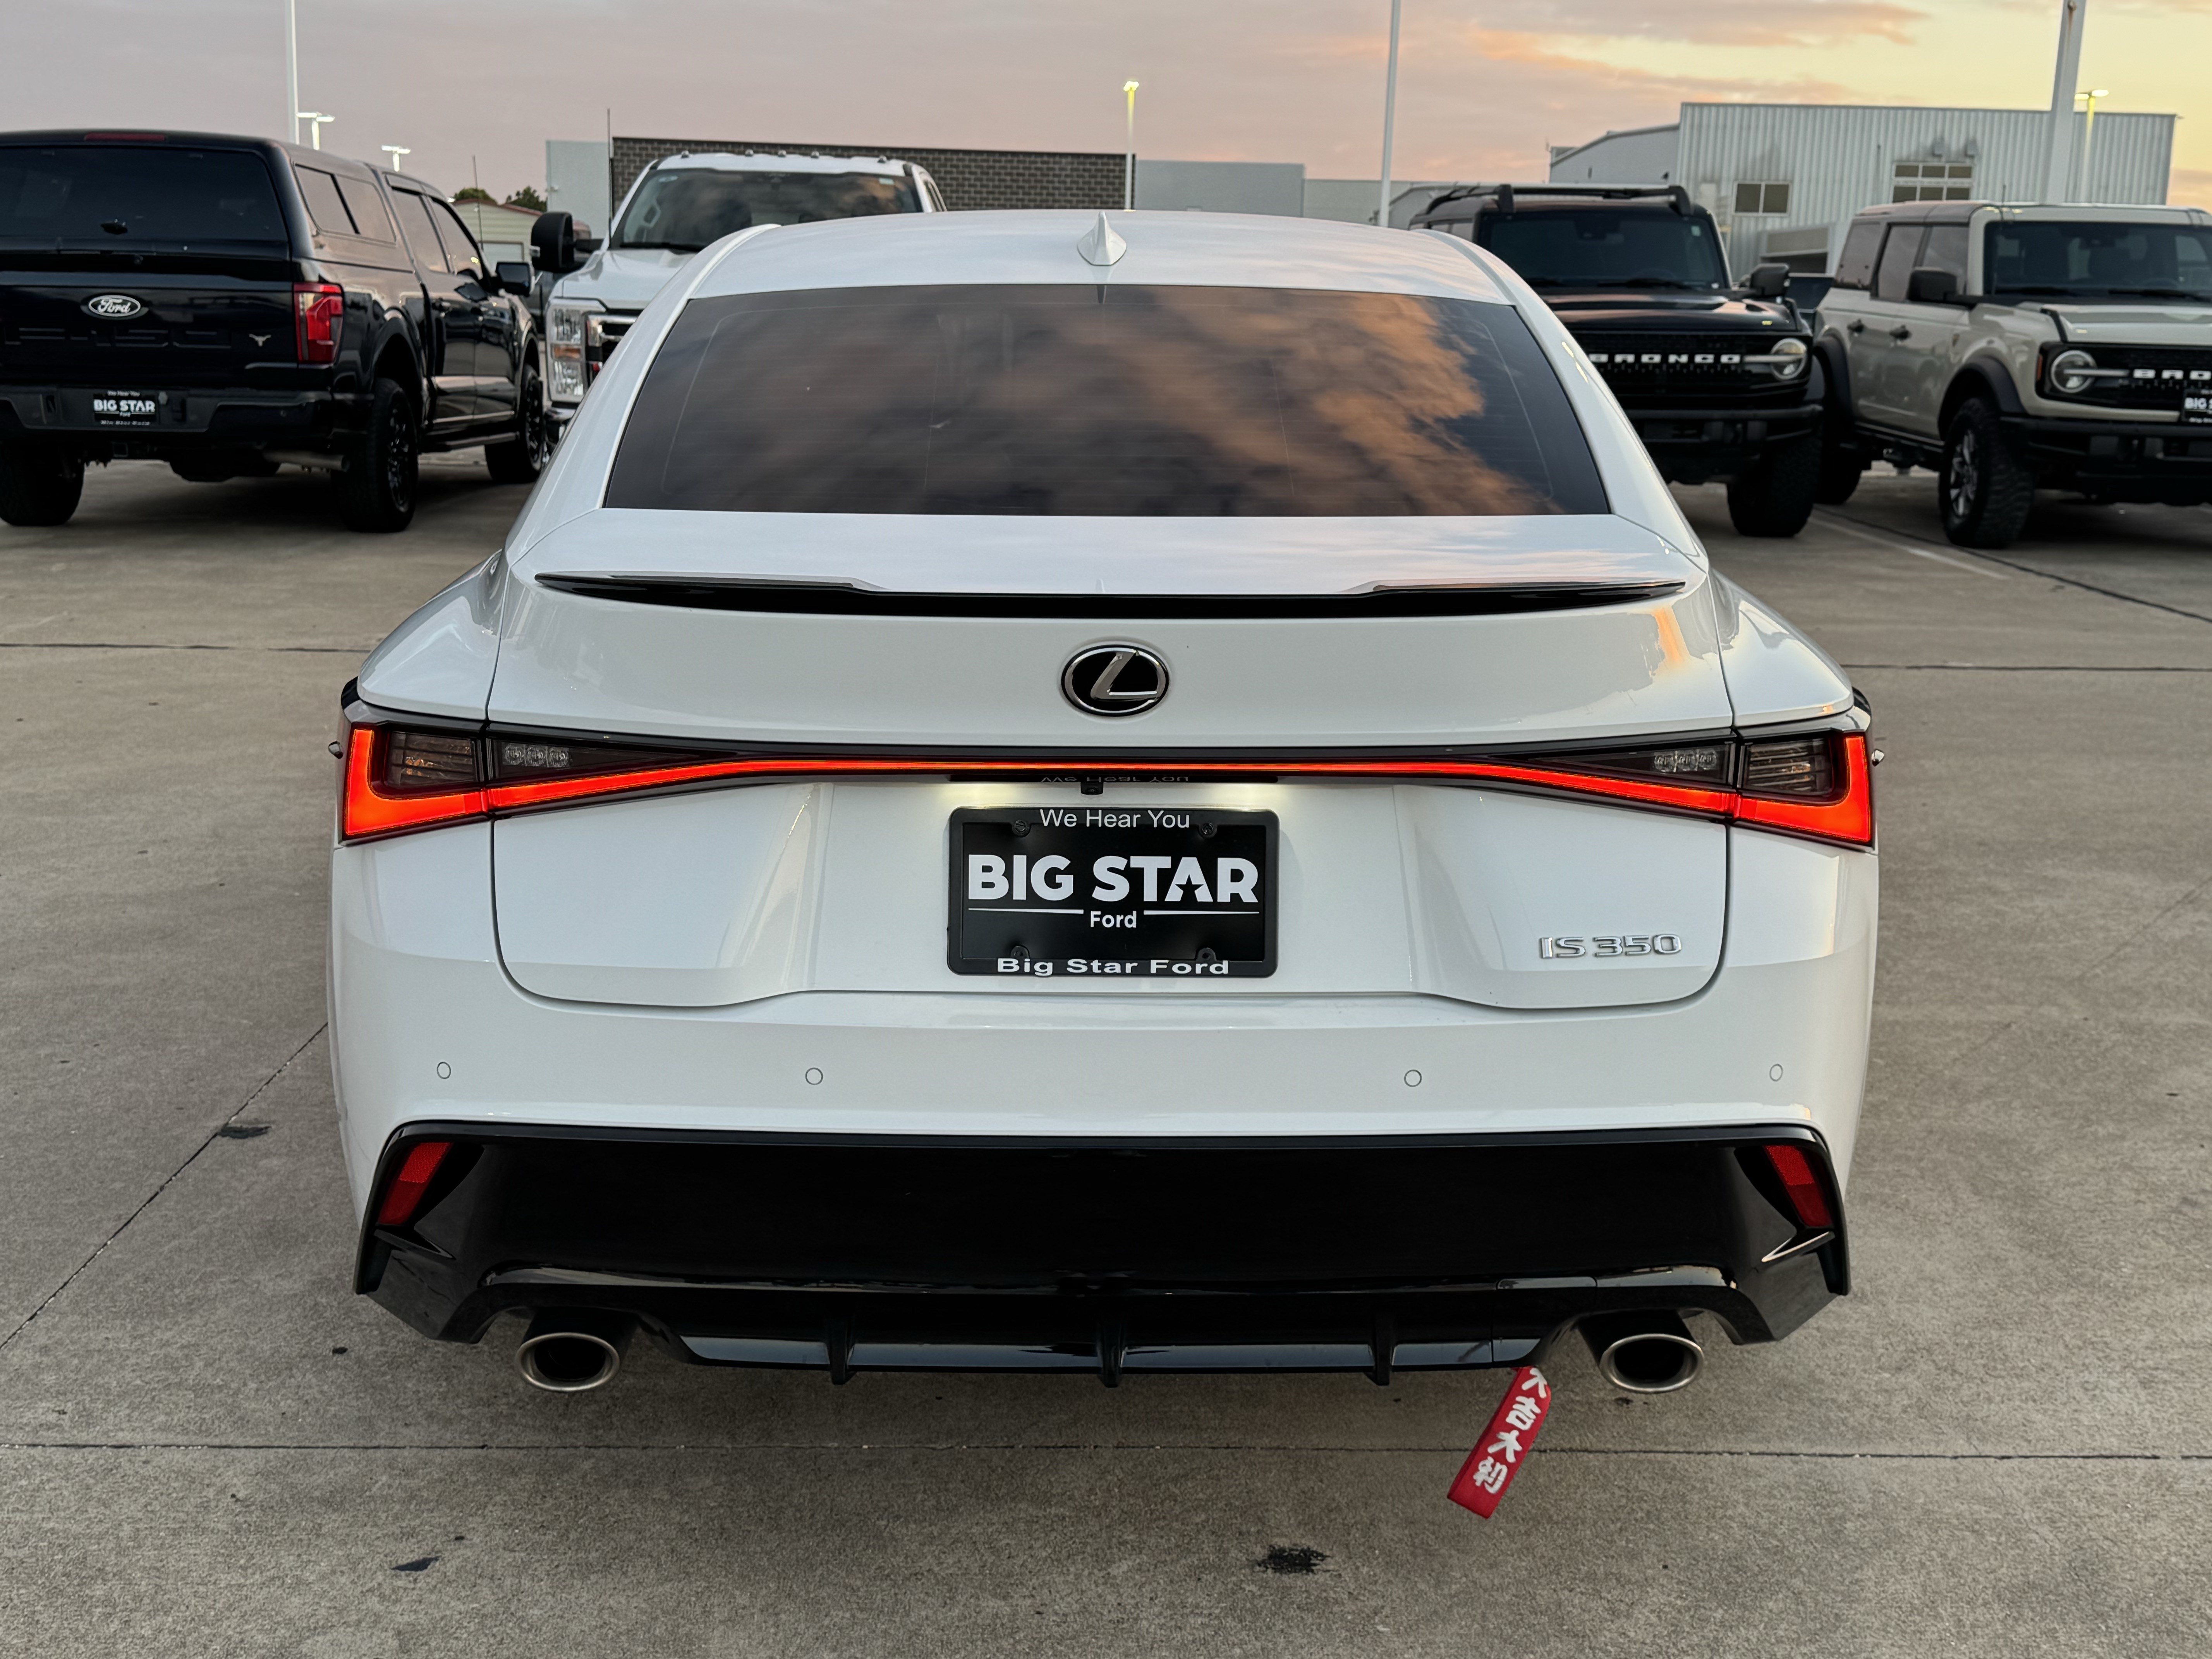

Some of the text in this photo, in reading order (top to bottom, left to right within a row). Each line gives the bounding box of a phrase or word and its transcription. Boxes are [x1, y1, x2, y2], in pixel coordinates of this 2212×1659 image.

[98, 297, 131, 313] Ford
[1589, 354, 1741, 364] BRONCO
[94, 399, 155, 412] BIG STAR
[1040, 809, 1190, 828] We Hear You
[968, 854, 1259, 903] BIG STAR
[1091, 910, 1137, 928] Ford
[1540, 934, 1682, 959] IS 350
[997, 958, 1228, 976] Big Star Ford
[1473, 1367, 1547, 1494] 大吉大利
